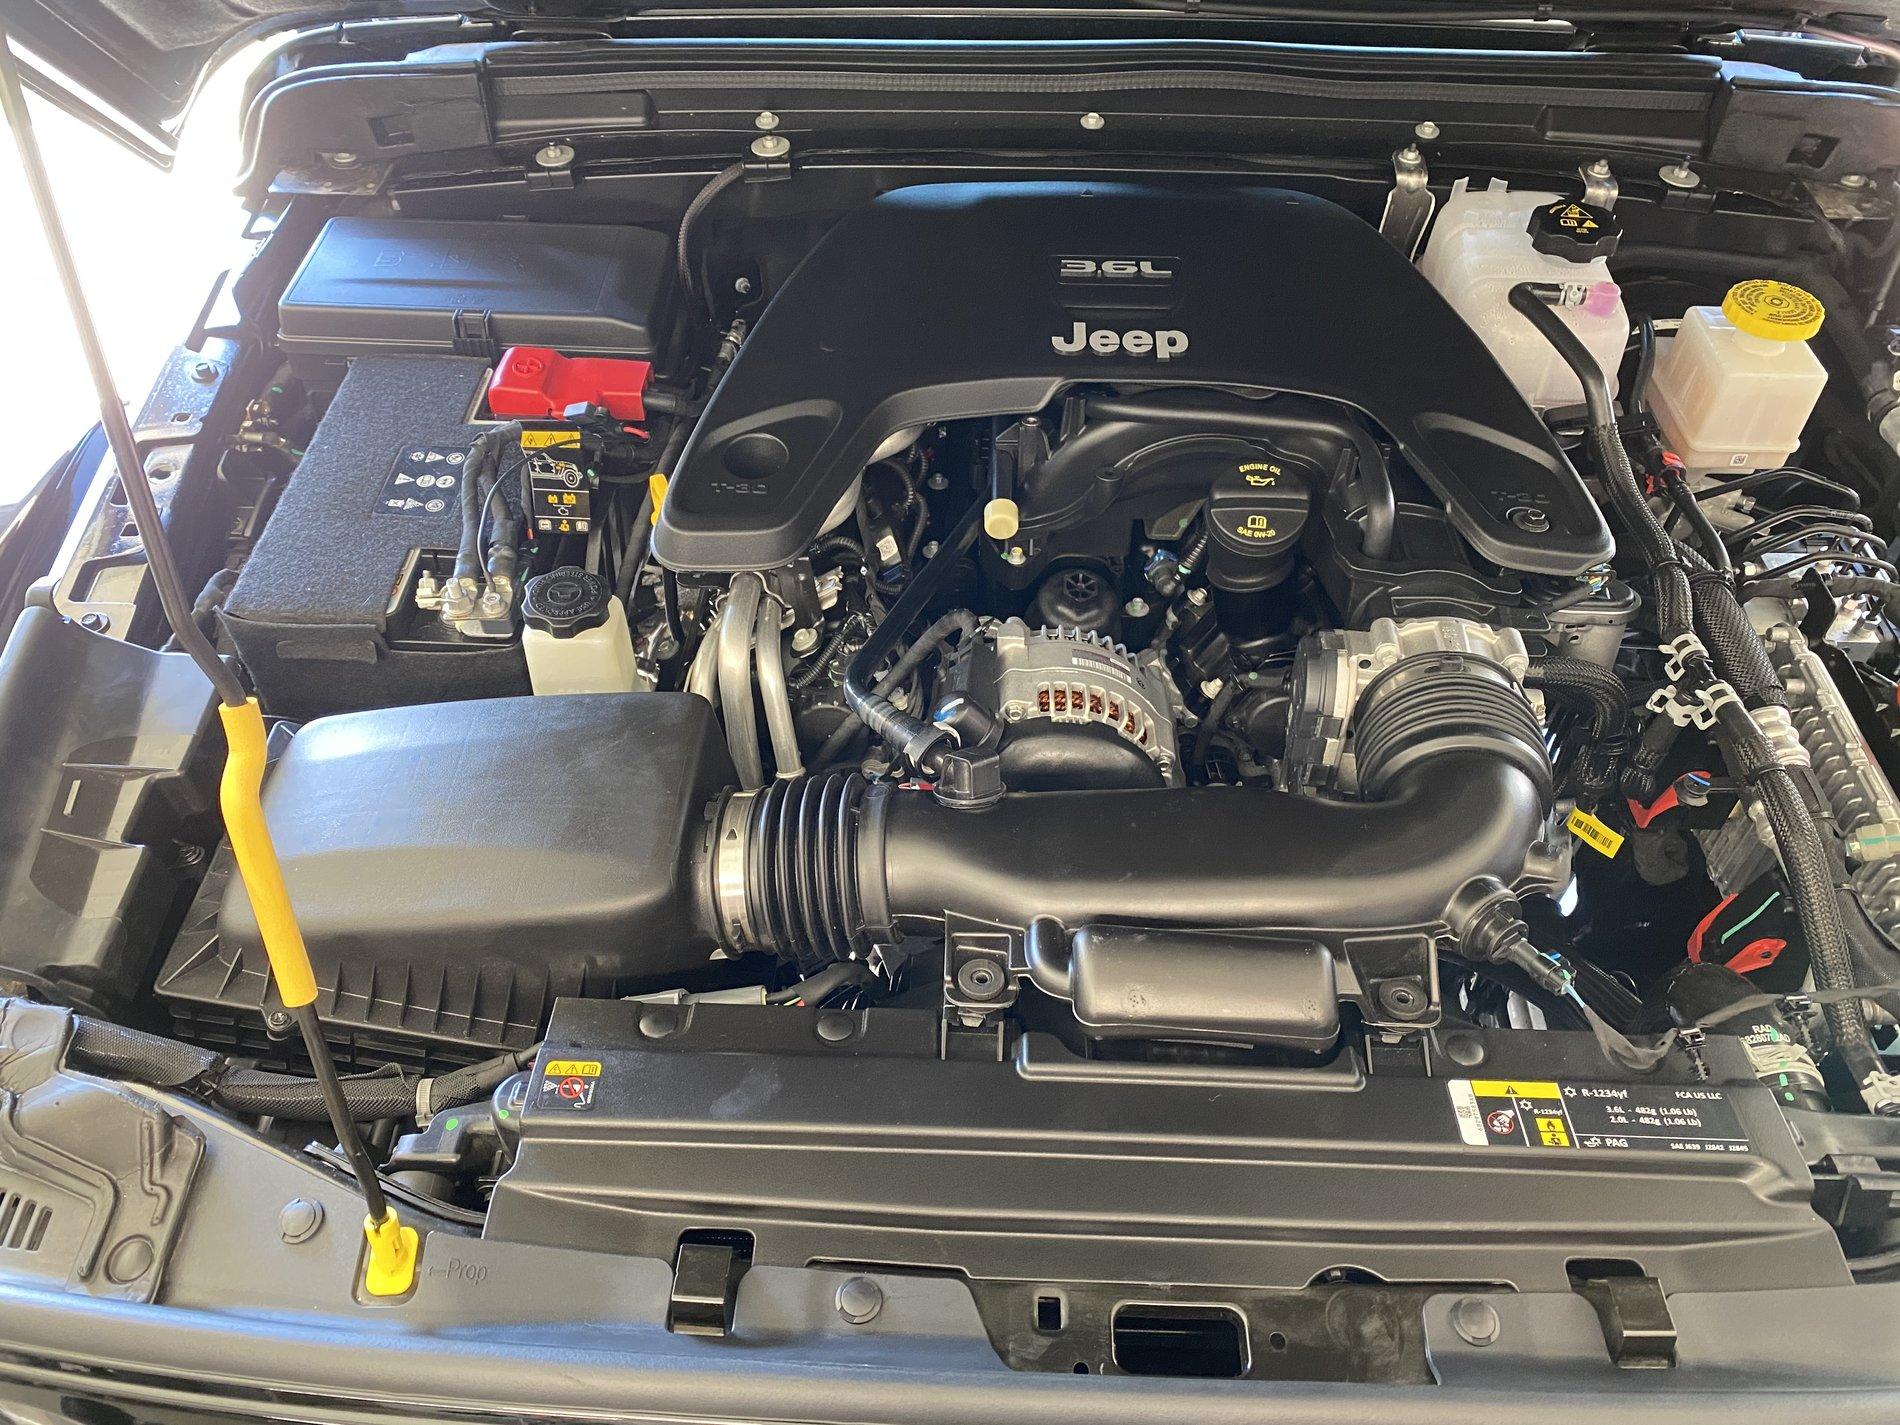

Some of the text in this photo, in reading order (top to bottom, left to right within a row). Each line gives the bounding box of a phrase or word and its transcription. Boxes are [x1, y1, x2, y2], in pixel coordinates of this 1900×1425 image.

[1060, 259, 1173, 278] 3.6L
[1051, 321, 1189, 362] Jeep
[1238, 463, 1281, 476] ENGINE OIL
[1236, 526, 1276, 539] SAE 0W-20
[1751, 1024, 1773, 1034] RAD
[1581, 1088, 1628, 1099] R-1234yf
[1675, 1091, 1693, 1099] FCA
[1707, 1092, 1722, 1100] LLC
[1605, 1105, 1625, 1114] 3.6L
[1635, 1106, 1657, 1116] 482g
[1659, 1106, 1682, 1116] (1.06
[1683, 1107, 1698, 1117] Lb)
[1609, 1116, 1629, 1124] 2.0L
[1639, 1116, 1662, 1126] 482g
[1664, 1117, 1686, 1127] (1.06
[1686, 1118, 1702, 1127] Lb)
[1605, 1138, 1629, 1148] PAG
[445, 1257, 488, 1286] Prop
